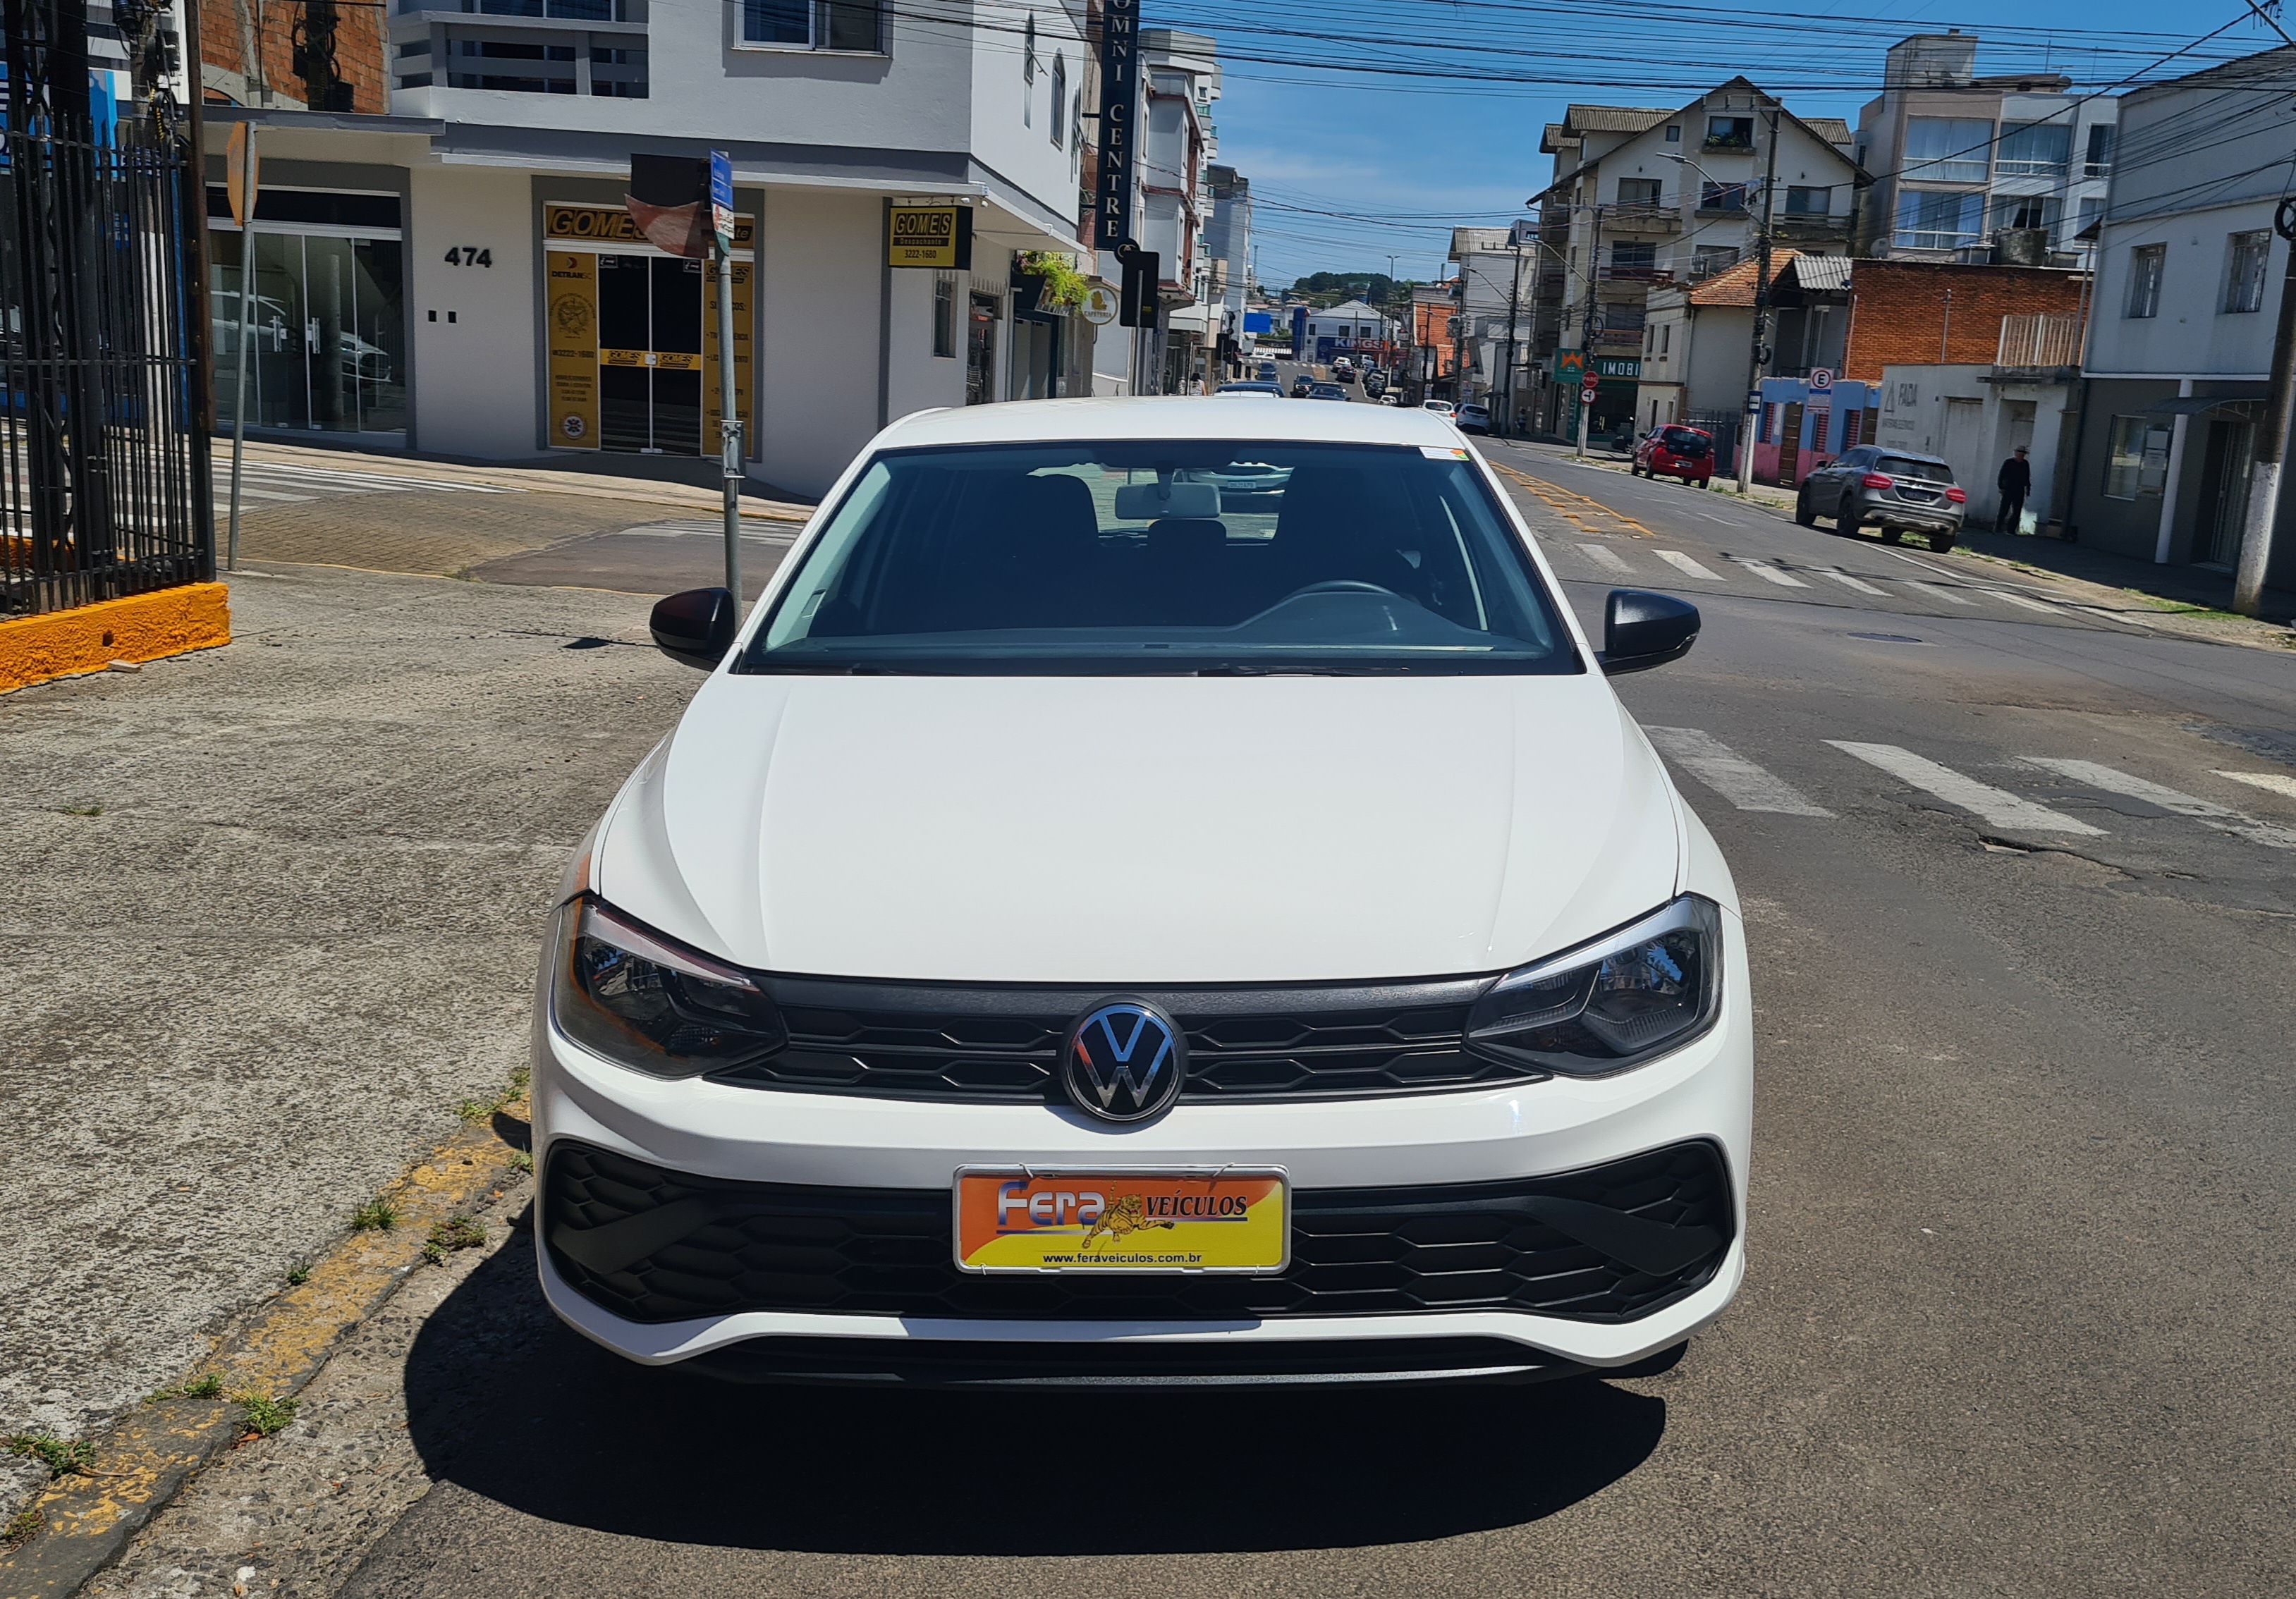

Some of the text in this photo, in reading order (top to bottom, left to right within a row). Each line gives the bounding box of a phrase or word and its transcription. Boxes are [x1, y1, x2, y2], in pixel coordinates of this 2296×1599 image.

[1106, 104, 1124, 238] CENTRE
[896, 214, 951, 234] GOMES
[444, 247, 492, 268] 474
[904, 249, 937, 259] 3222-1680
[1818, 374, 1826, 384] E
[1146, 1189, 1247, 1216] VEÍCULOS
[1043, 1252, 1202, 1263] www.feraveiculos.com.br
